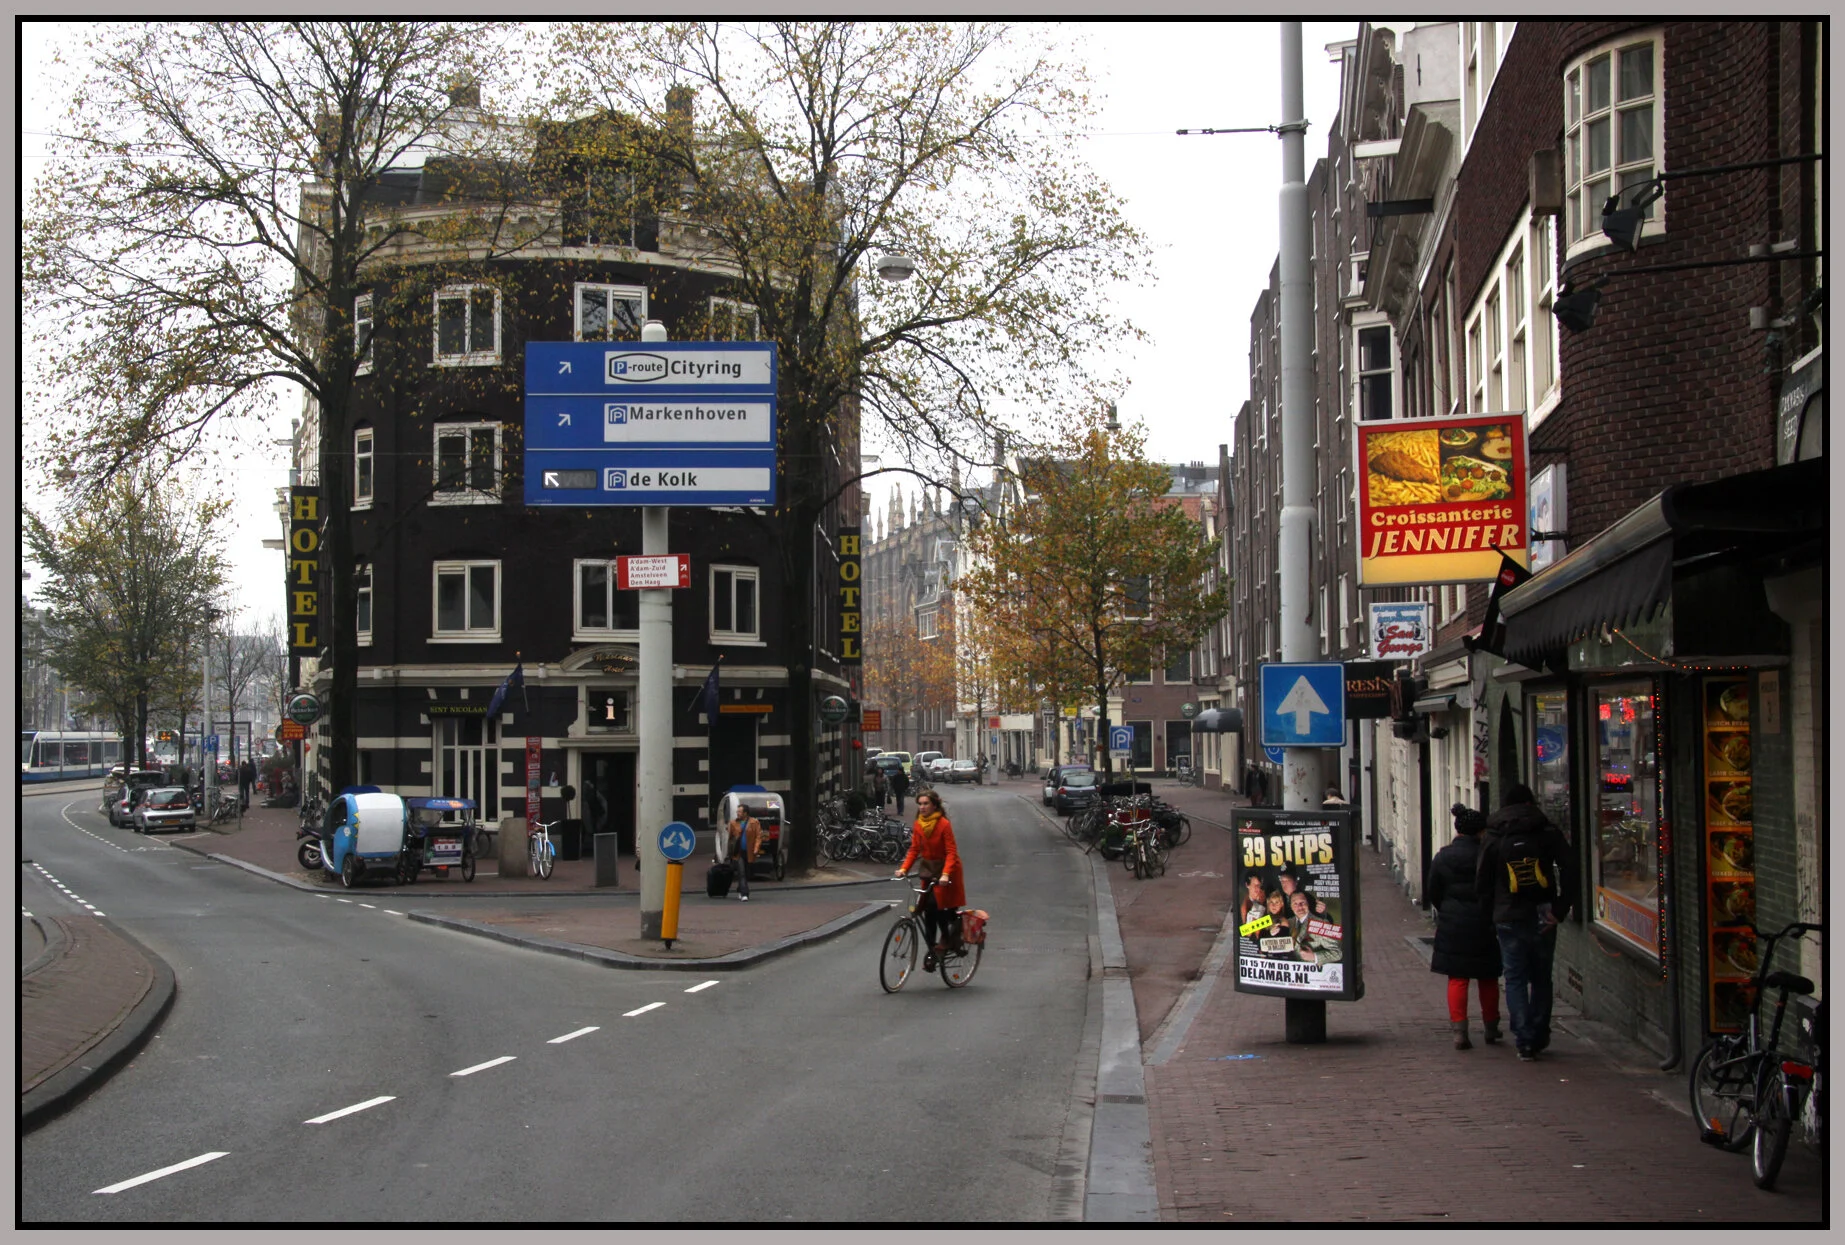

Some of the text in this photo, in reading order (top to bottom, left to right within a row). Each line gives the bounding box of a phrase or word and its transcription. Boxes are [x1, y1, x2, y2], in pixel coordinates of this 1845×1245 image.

[671, 360, 742, 378] Cityring
[630, 406, 747, 420] Markenhoven
[630, 473, 651, 486] de
[658, 472, 697, 486] Kolk
[1370, 505, 1513, 527] Croissanterie
[1368, 524, 1520, 560] JENNIFER
[292, 496, 319, 648] HOTEL
[644, 579, 661, 587] Haag
[839, 535, 860, 659] HOTEL
[1385, 625, 1415, 640] San
[1377, 640, 1424, 658] George
[1243, 832, 1333, 867] 39 STEPS
[1240, 958, 1323, 973] DI 15 T/M DO 17 NOV
[1240, 966, 1310, 984] DELAMAR.NL
